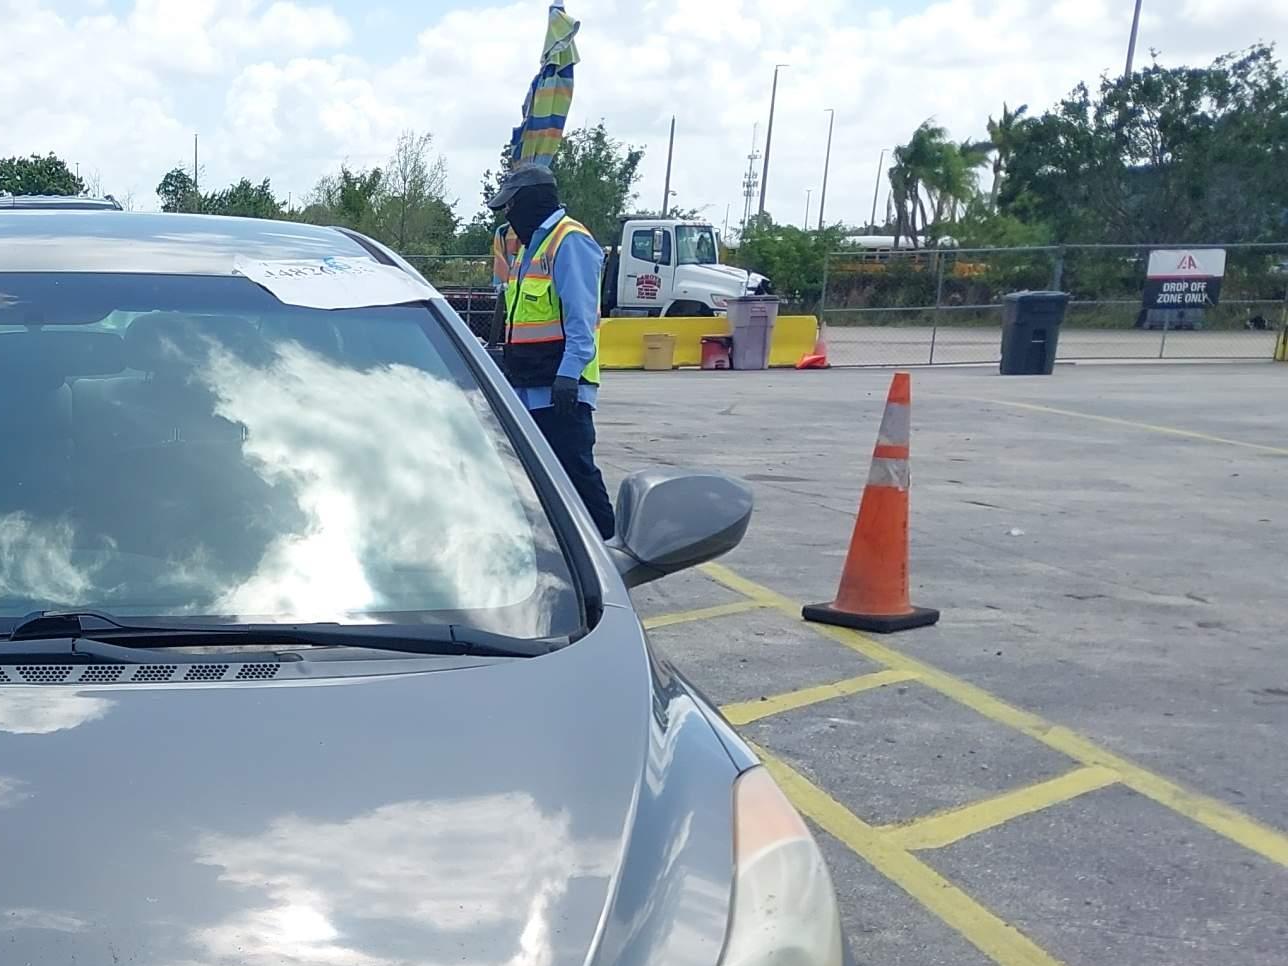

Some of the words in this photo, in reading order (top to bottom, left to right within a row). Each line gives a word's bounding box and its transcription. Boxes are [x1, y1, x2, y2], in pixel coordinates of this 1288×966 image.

[1162, 281, 1189, 292] DROP
[1190, 281, 1208, 292] OFF
[1156, 293, 1183, 303] ZONE
[1184, 293, 1208, 304] ONLY
